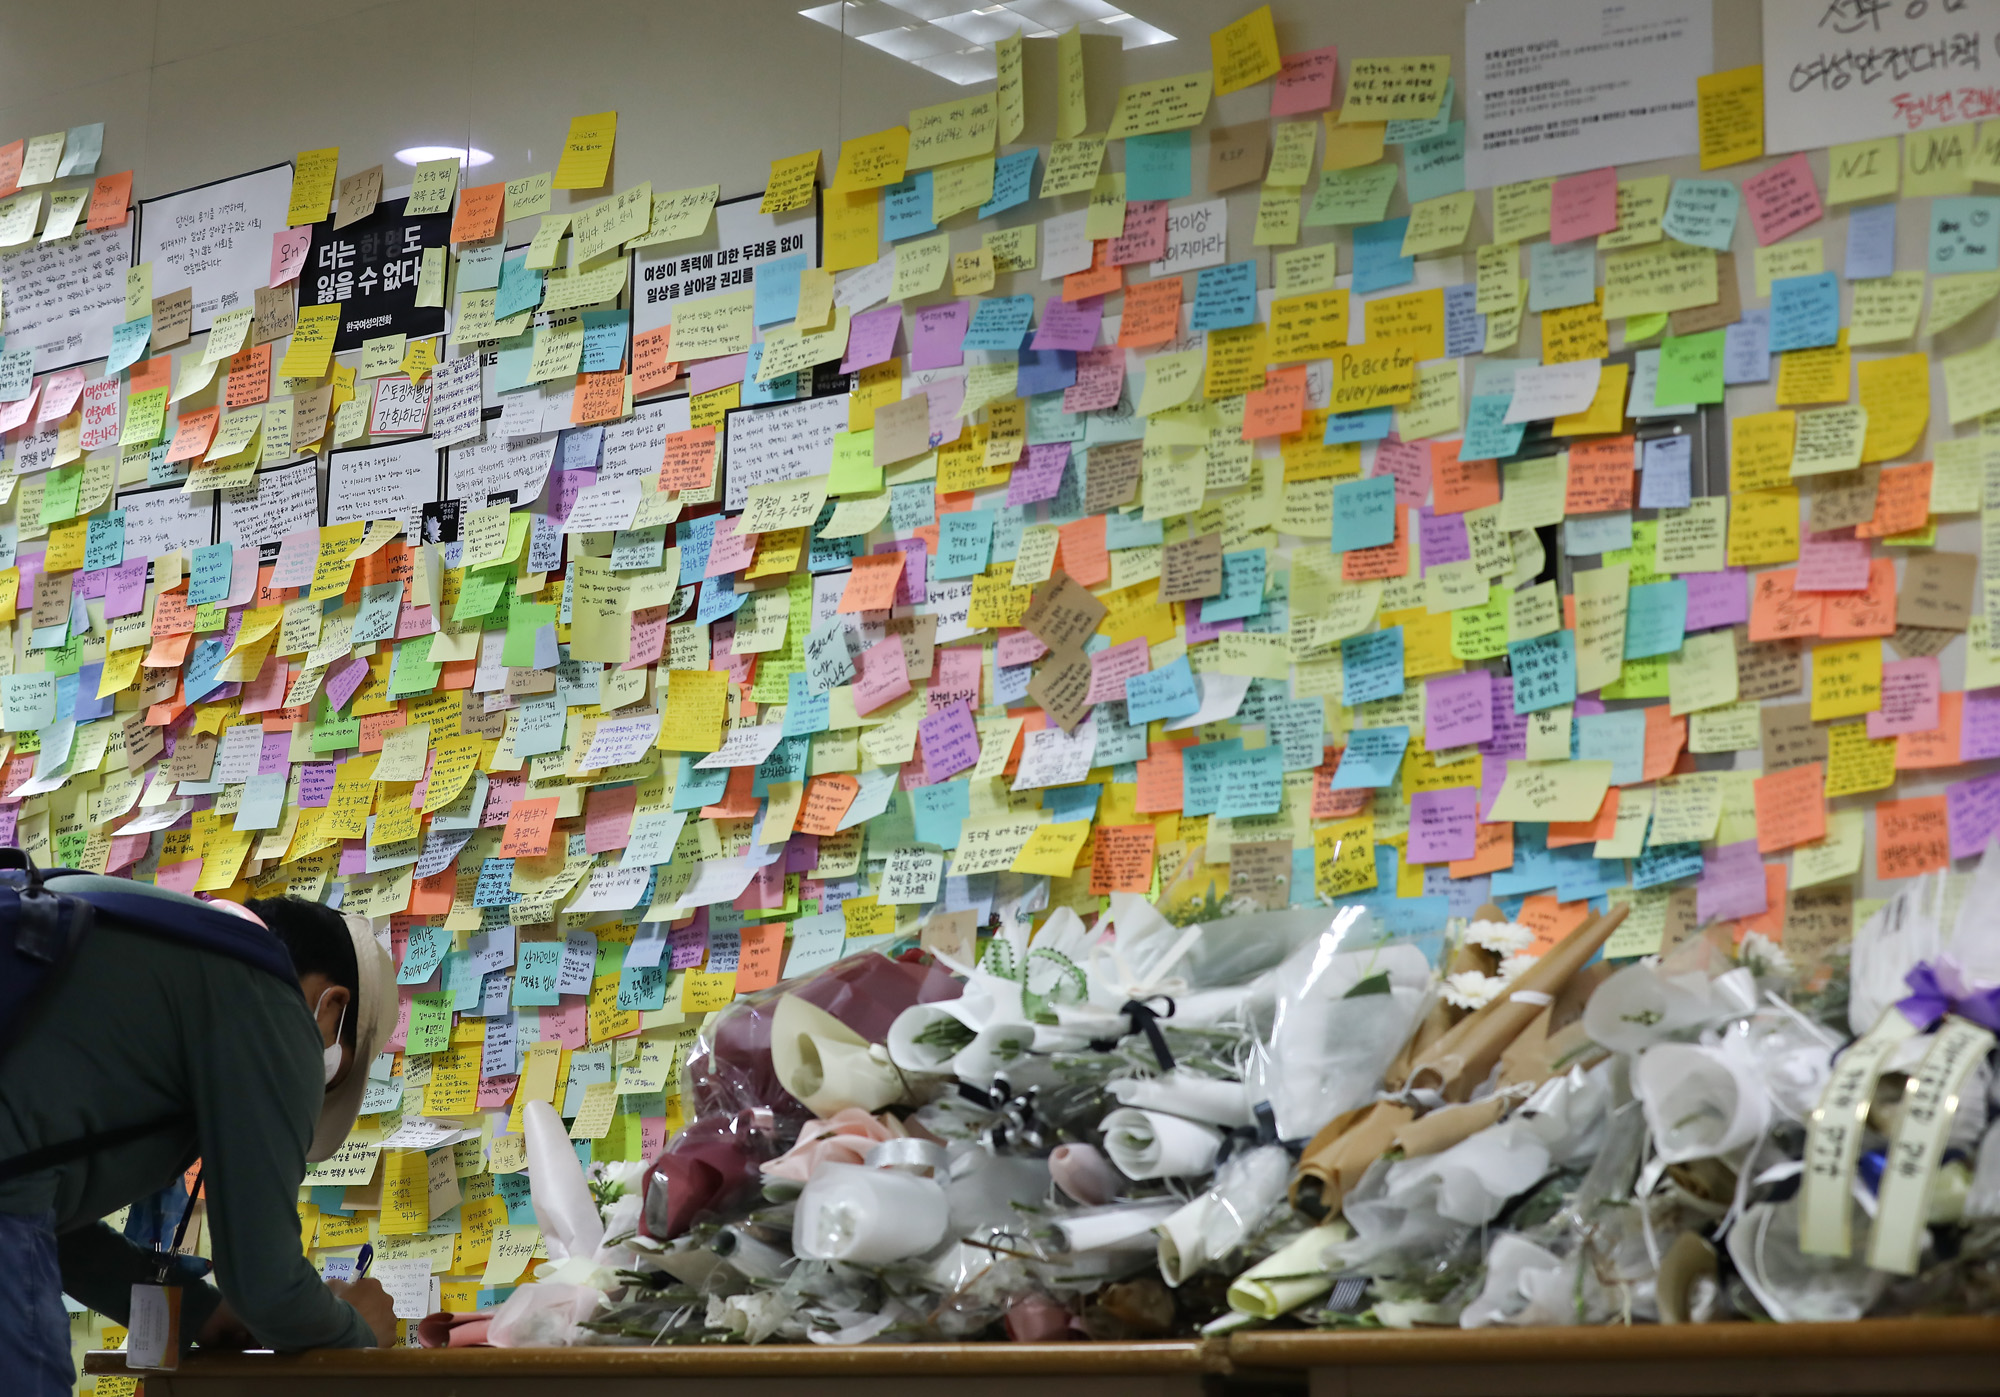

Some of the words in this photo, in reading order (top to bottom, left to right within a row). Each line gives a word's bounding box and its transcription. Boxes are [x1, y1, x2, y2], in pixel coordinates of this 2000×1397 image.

[318, 240, 356, 271] 더는
[644, 260, 677, 282] 여성이
[680, 254, 713, 274] 폭력에
[717, 250, 740, 267] 대한
[743, 241, 778, 261] 두려움
[780, 233, 804, 250] 없이
[316, 266, 355, 304] 잃을
[358, 266, 378, 296] 수
[382, 260, 423, 290] 없다
[646, 283, 680, 304] 일상을
[684, 276, 716, 296] 살아갈
[720, 267, 754, 288] 권리를
[346, 314, 392, 332] 한국여성의전화
[1341, 353, 1389, 381] Peace
[1393, 347, 1412, 368] for
[85, 378, 119, 401] 여성안전
[85, 402, 117, 425] 안중에도
[379, 408, 426, 431] 강화하라
[114, 620, 146, 635] FEMICIDE
[60, 813, 76, 824] STOP
